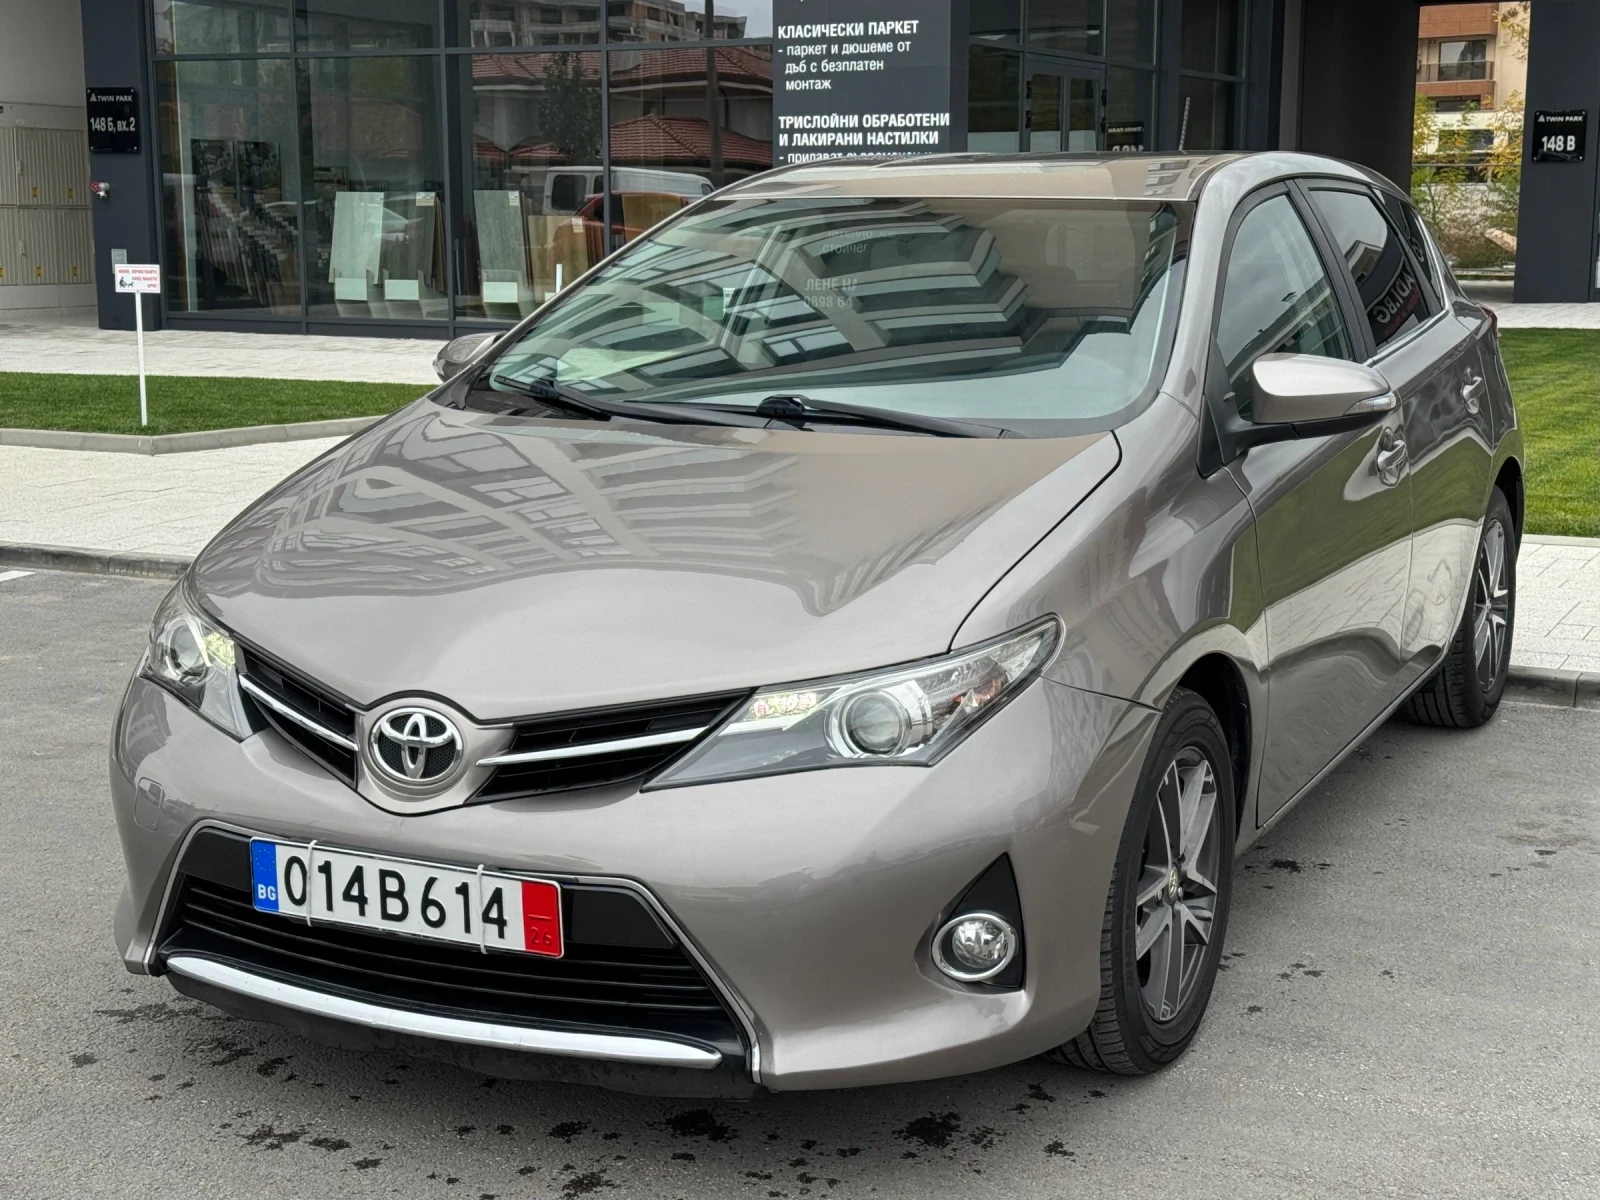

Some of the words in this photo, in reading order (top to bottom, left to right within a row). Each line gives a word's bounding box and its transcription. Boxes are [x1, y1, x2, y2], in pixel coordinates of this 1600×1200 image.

[778, 21, 864, 39] КЛАСИЧЕСКИ
[868, 20, 919, 36] ПАРКЕТ
[787, 44, 827, 58] паркет
[831, 45, 838, 55] и
[842, 42, 893, 56] дюшеме
[897, 41, 911, 52] от
[785, 60, 806, 74] дъб
[810, 62, 817, 73] с
[821, 59, 884, 72] безплатен
[785, 78, 831, 91] монтаж
[90, 117, 106, 132] 148
[107, 117, 116, 134] Б,
[129, 116, 136, 132] 2
[778, 113, 859, 129] ТРИСЛОЙНИ
[862, 112, 950, 127] ОБРАБОТЕНИ
[779, 133, 788, 147] И
[791, 132, 863, 147] ЛАКИРАНИ
[866, 131, 939, 146] НАСТИЛКИ
[1541, 134, 1564, 152] 148
[257, 883, 276, 900] BG
[284, 855, 508, 939] 014B614
[530, 926, 552, 945] 26
